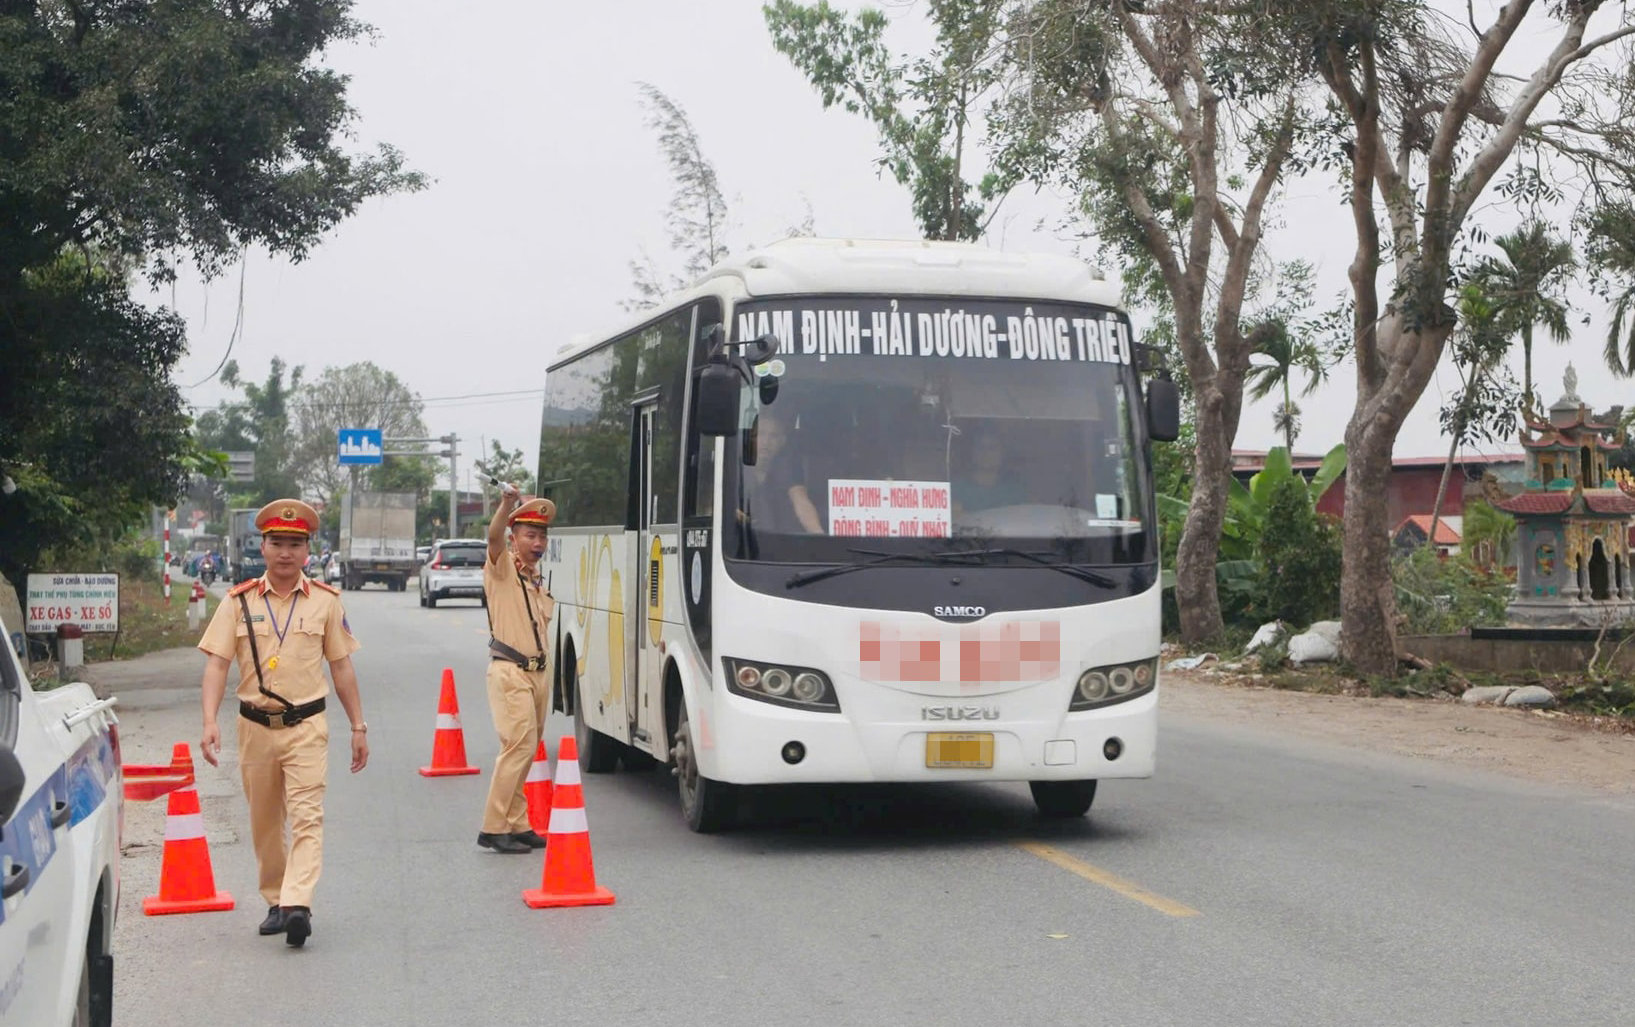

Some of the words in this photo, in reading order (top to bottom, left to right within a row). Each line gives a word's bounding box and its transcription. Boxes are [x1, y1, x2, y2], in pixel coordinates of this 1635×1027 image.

[738, 310, 795, 357] NAM
[1072, 311, 1132, 366] TRIỀU
[921, 488, 948, 509] HƯNG
[30, 606, 45, 620] XE
[47, 606, 72, 620] GAS
[81, 606, 96, 620] XE
[98, 600, 112, 619] SỐ
[933, 605, 986, 617] SAMCO
[920, 705, 1001, 721] ISUZU
